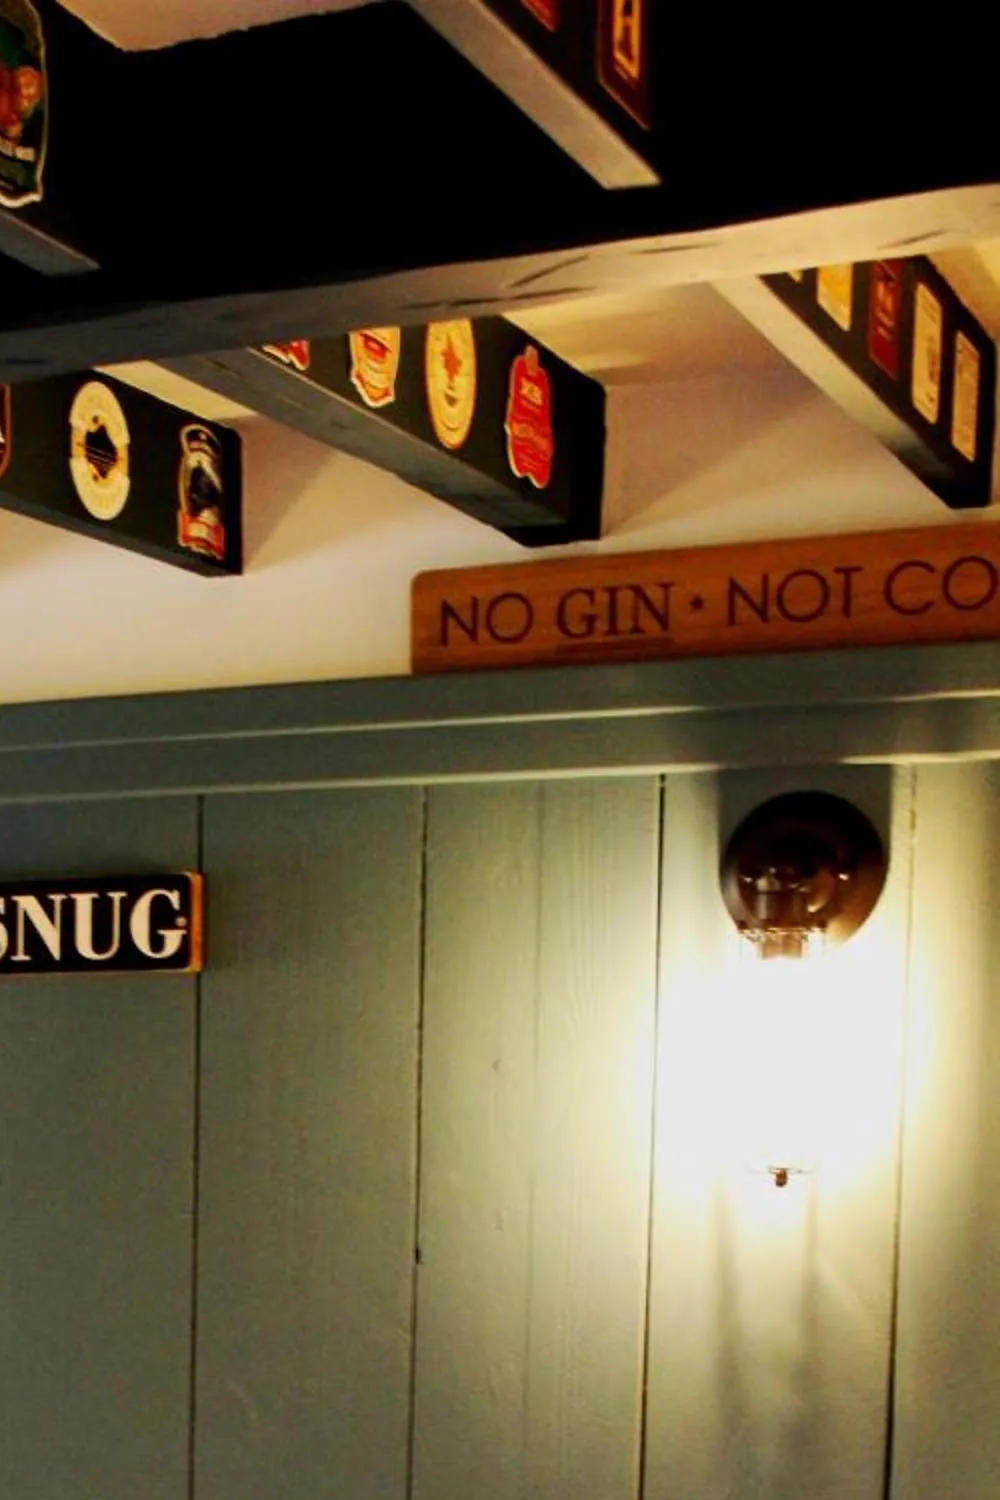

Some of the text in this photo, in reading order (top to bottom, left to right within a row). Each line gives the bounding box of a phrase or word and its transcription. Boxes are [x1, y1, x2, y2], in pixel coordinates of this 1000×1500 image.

[439, 555, 999, 647] NO GIN NOT CO
